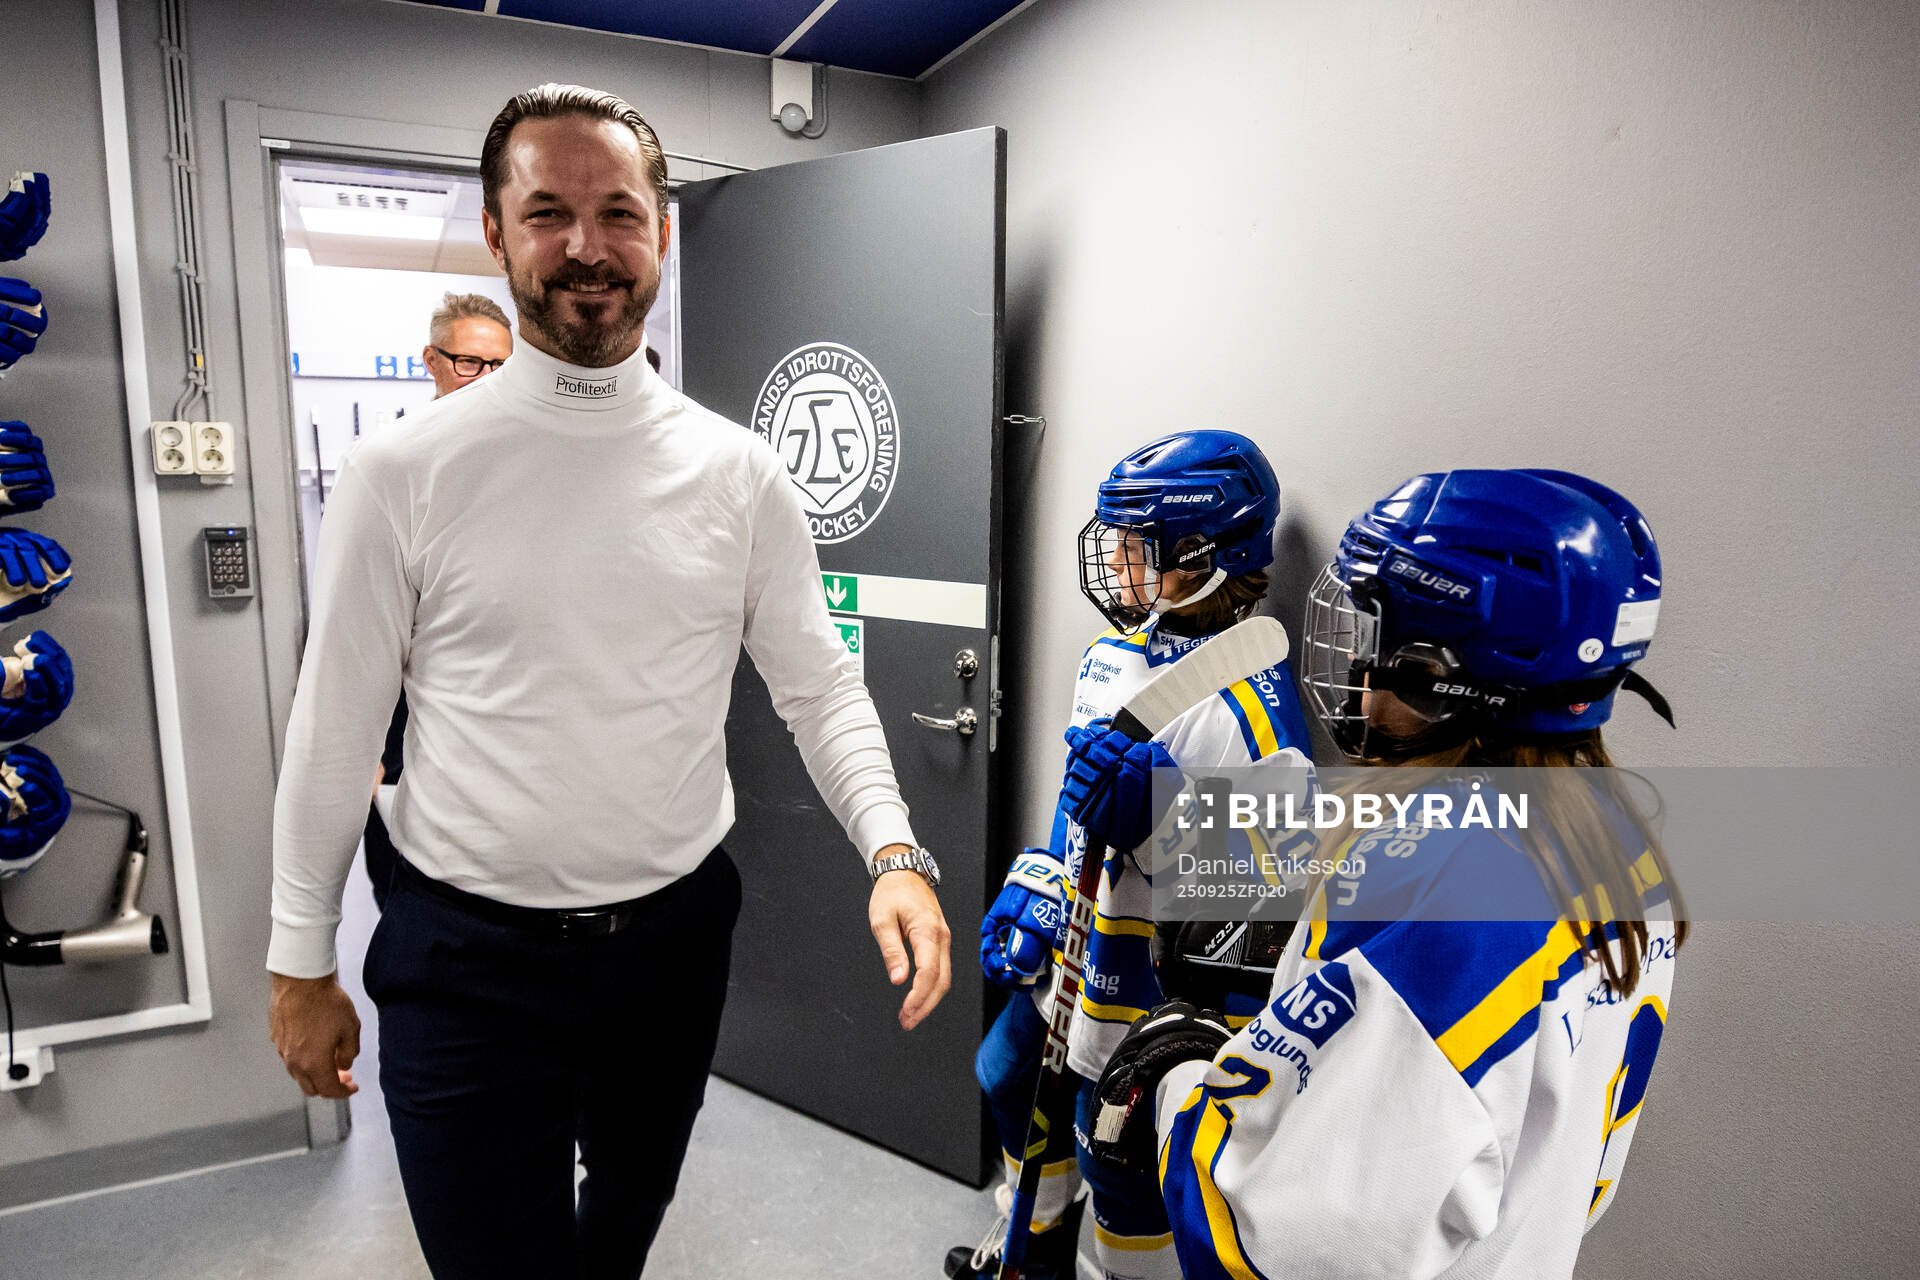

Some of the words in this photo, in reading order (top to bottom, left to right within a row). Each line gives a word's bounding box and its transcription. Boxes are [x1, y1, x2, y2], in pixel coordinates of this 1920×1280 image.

[555, 376, 617, 396] Profiltextil
[787, 350, 894, 493] IDROTTSFÖRENING
[1161, 494, 1214, 504] BAUER
[1178, 542, 1216, 564] BAUER
[1389, 559, 1472, 599] BAUER
[1432, 682, 1506, 707] BAUR
[1043, 891, 1095, 1075] BAUER
[1281, 978, 1337, 1029] NS
